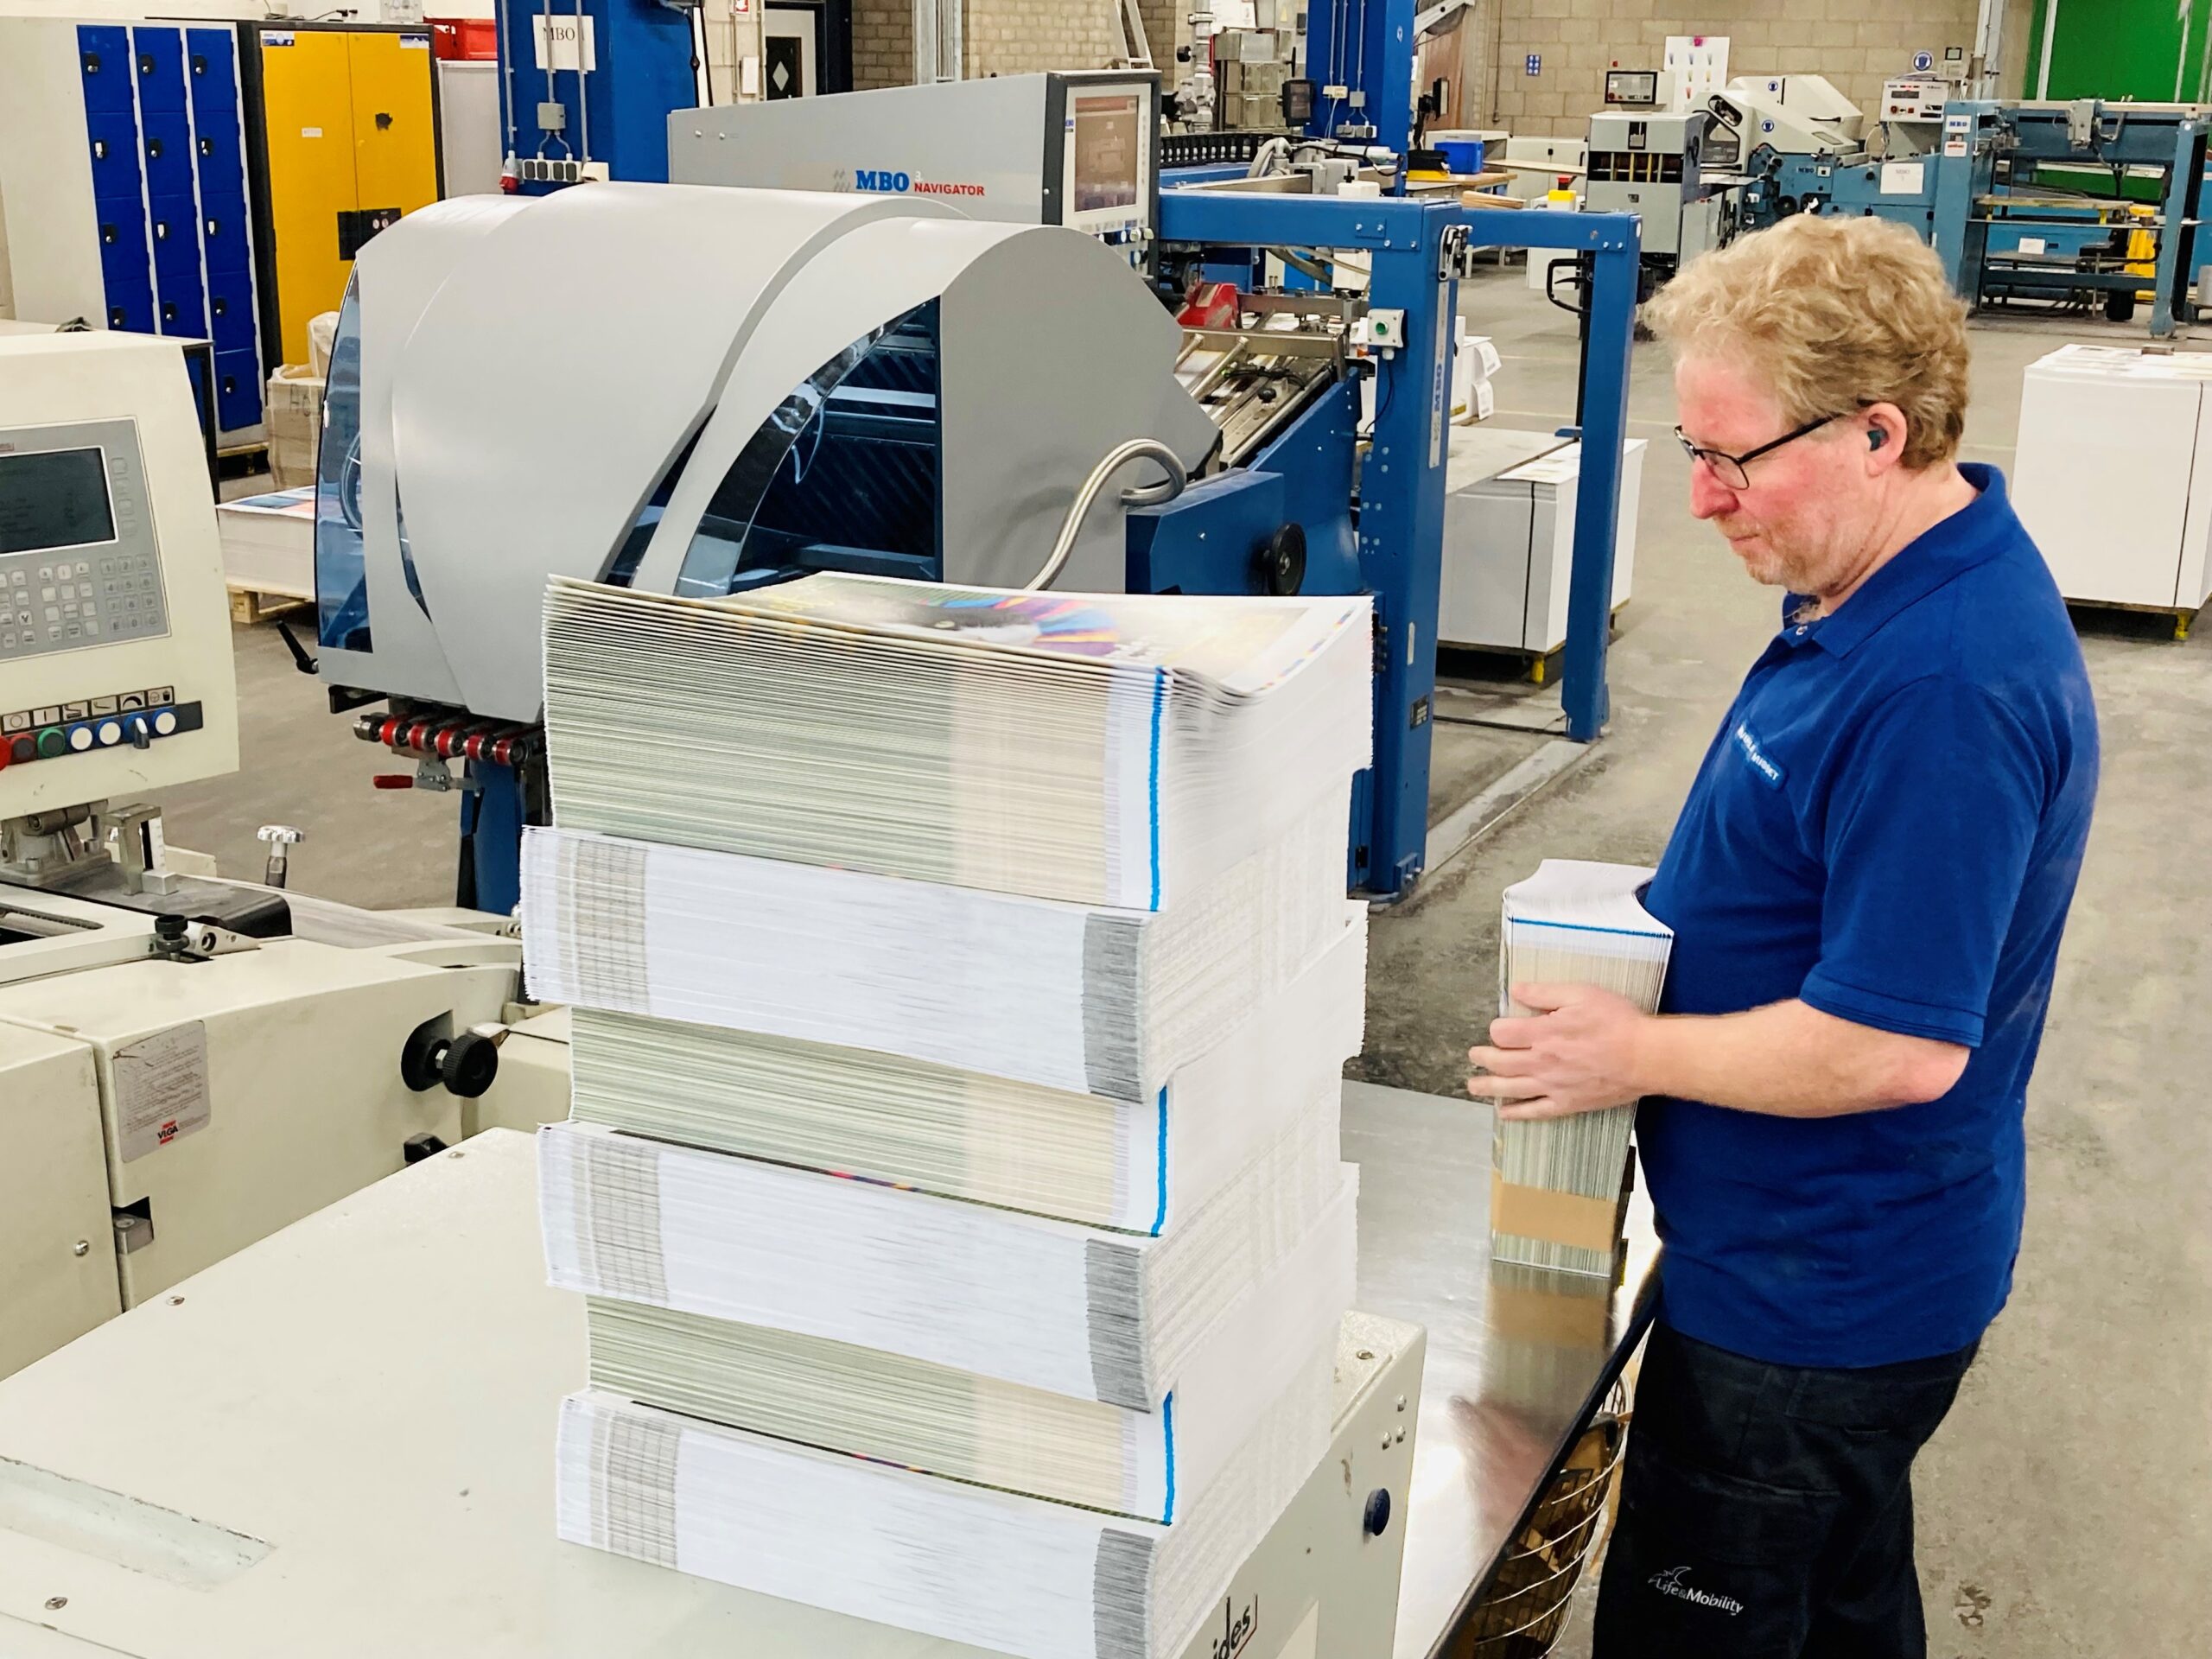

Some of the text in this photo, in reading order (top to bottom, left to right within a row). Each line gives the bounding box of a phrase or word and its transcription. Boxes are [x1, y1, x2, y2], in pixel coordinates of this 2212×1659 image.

[543, 27, 575, 41] MBO
[855, 170, 910, 193] MBO
[914, 182, 985, 197] NAVIGATOR
